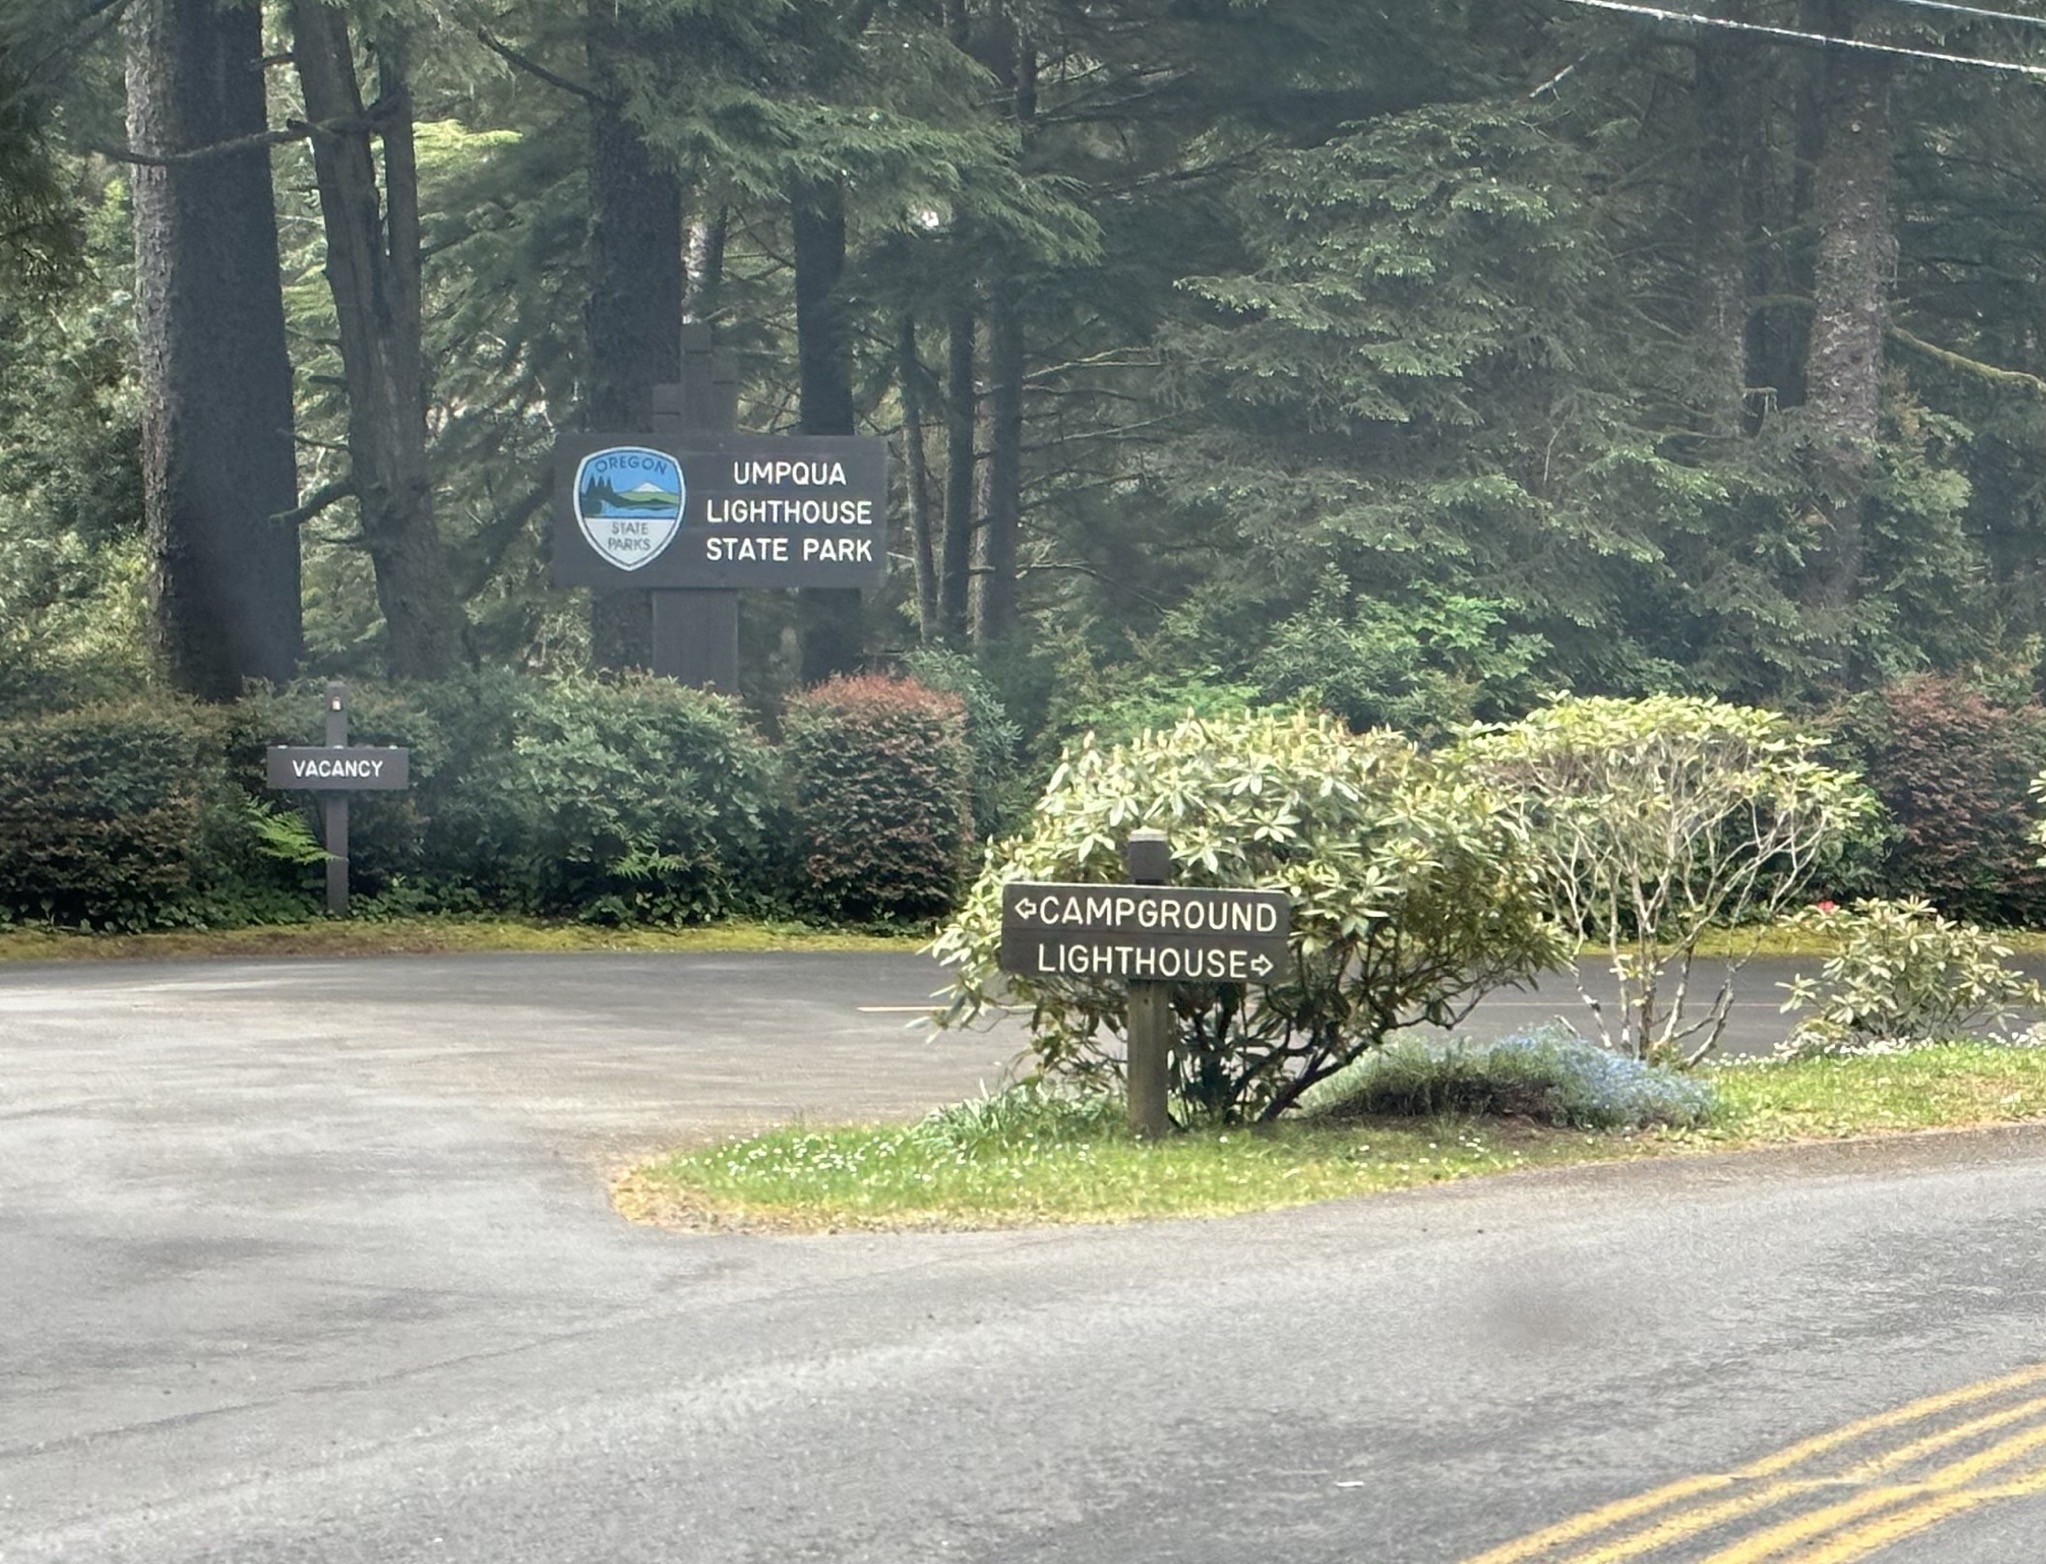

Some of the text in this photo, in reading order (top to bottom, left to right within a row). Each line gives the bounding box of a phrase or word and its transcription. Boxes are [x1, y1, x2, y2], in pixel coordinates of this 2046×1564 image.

[594, 455, 667, 475] OREGON
[733, 461, 847, 486] UMPQUA
[706, 499, 873, 525] LIGHTHOUSE
[611, 522, 649, 535] STATE
[607, 537, 652, 551] PARKS
[706, 537, 873, 562] STATE PARK
[292, 759, 384, 778] VACANCY
[1039, 895, 1277, 932] CAMPGROUND
[1038, 943, 1248, 979] LIGHTHOUSE
